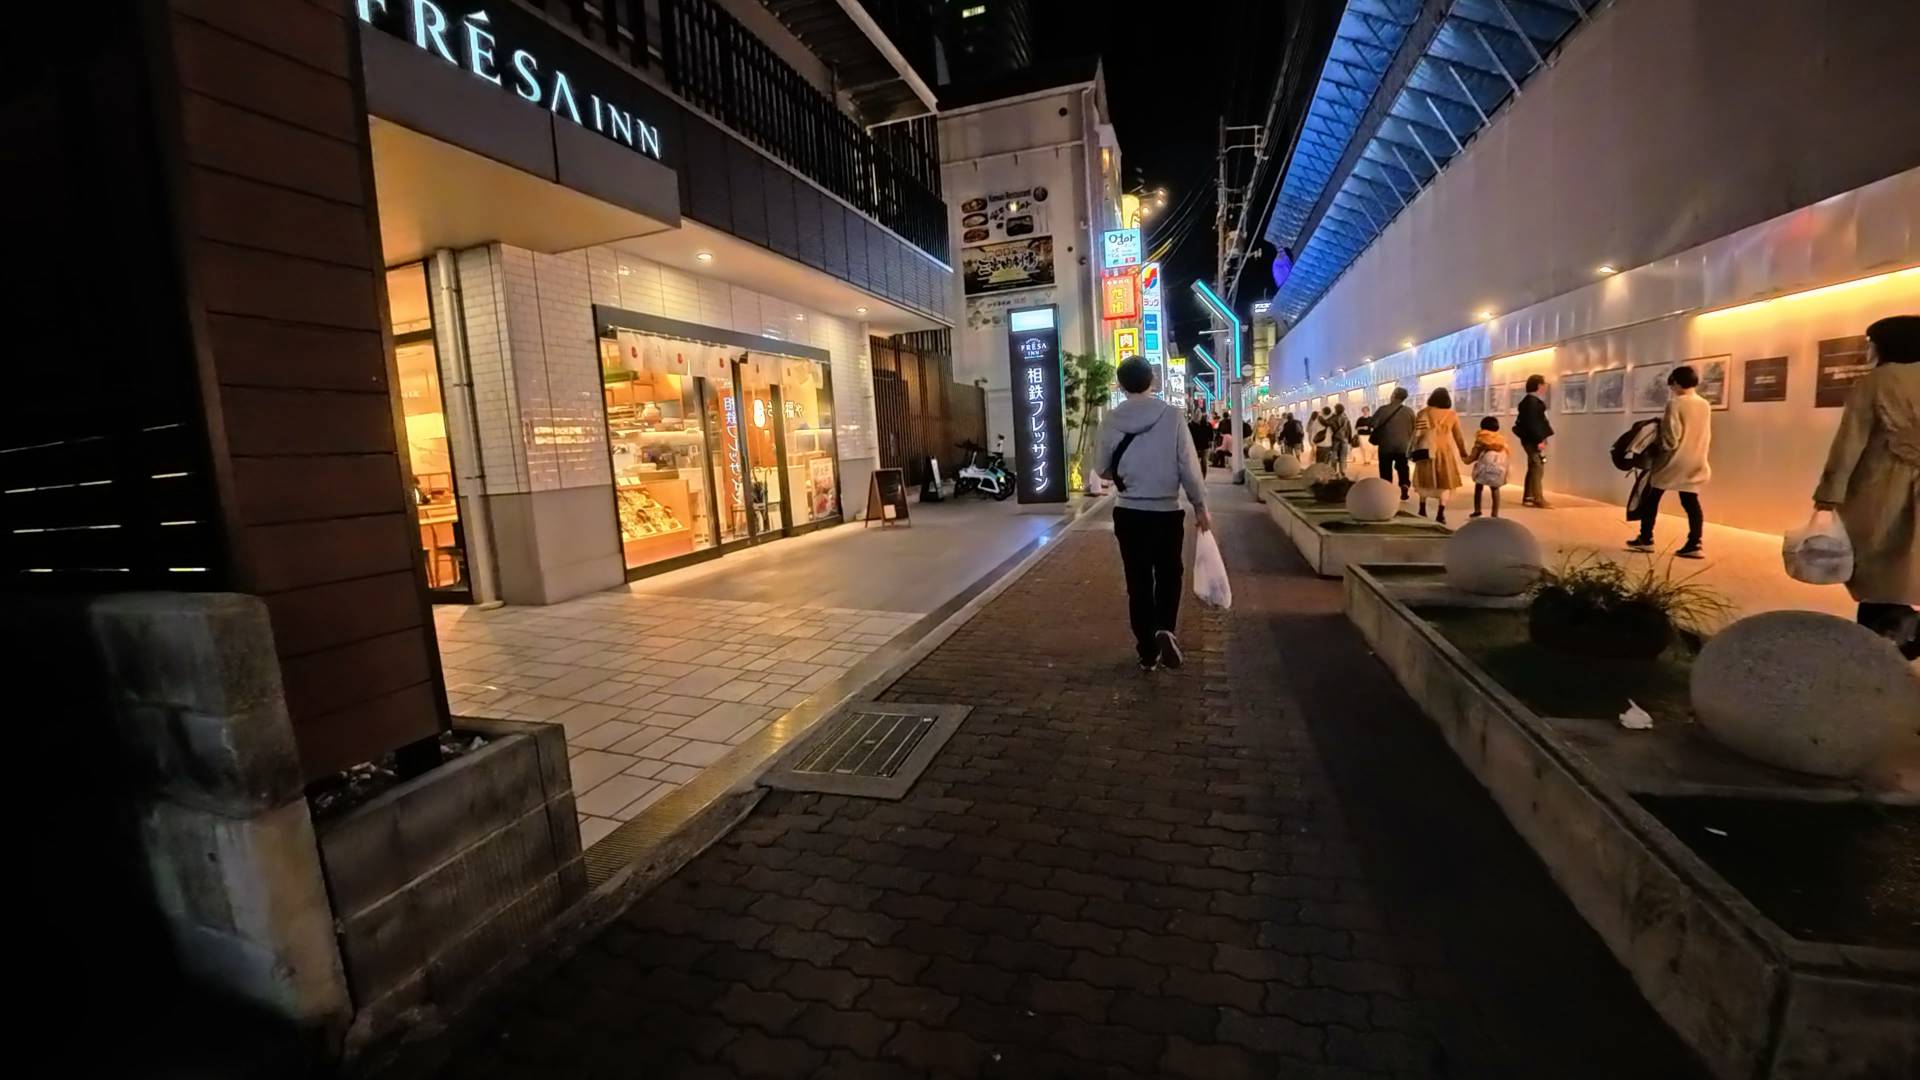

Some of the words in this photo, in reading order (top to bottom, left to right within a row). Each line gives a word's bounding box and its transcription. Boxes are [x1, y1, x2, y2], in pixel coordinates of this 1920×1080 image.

[591, 94, 662, 160] INN
[1027, 367, 1050, 493] 相鉄フレッサイン
